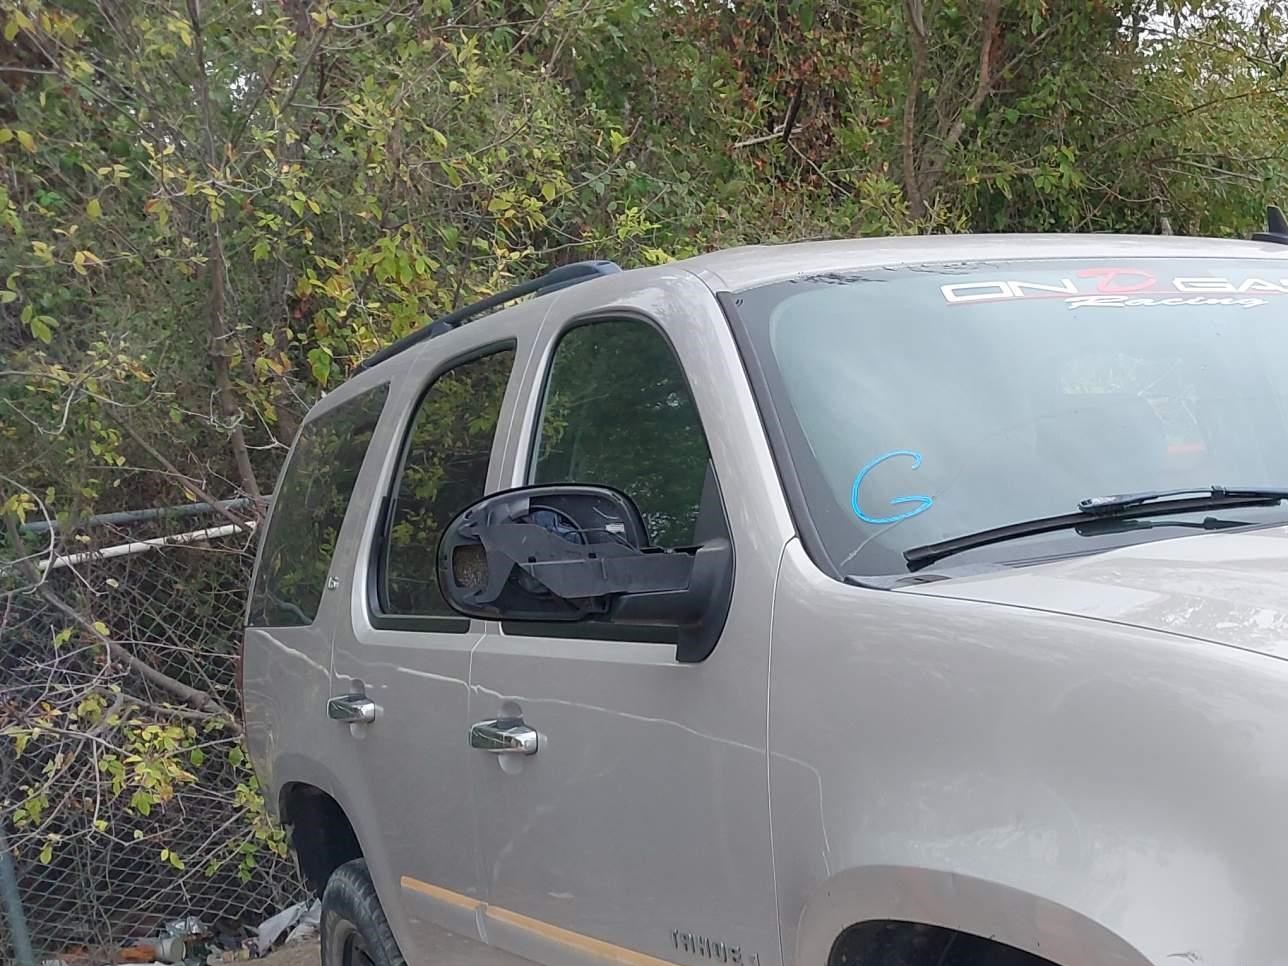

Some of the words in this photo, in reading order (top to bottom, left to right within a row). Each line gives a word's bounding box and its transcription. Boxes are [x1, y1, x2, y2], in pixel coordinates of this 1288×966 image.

[940, 279, 1079, 303] ON
[1063, 295, 1269, 310] Racing
[851, 449, 934, 524] G
